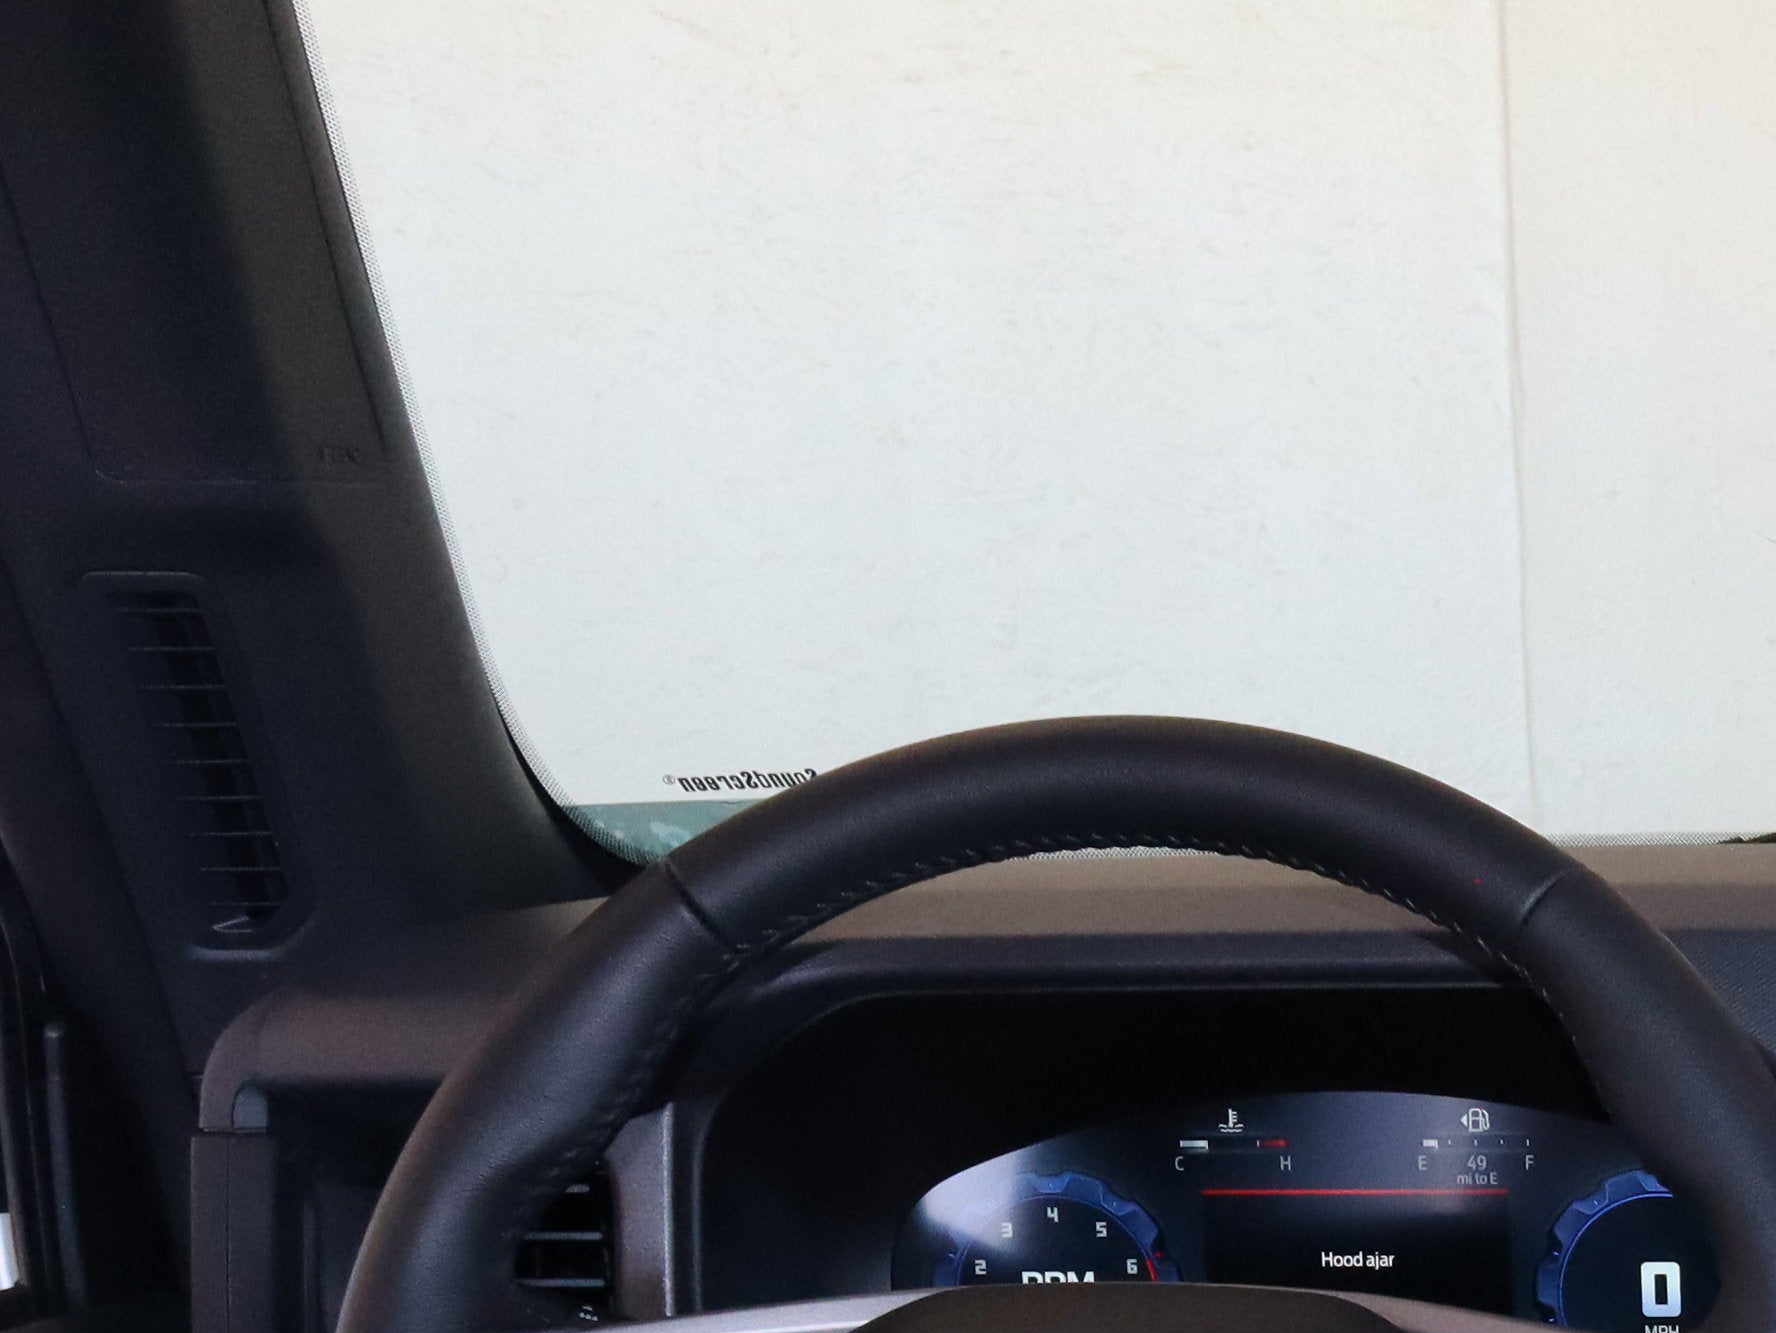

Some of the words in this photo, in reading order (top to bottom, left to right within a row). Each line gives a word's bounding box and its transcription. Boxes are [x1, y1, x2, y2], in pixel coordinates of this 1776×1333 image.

[1174, 1156, 1184, 1170] C
[1280, 1156, 1291, 1170] H
[1418, 1156, 1427, 1170] E
[1467, 1155, 1487, 1170] 49
[1525, 1155, 1534, 1170] F
[1457, 1173, 1473, 1184] mi
[1475, 1174, 1488, 1184] to
[1490, 1173, 1498, 1184] E
[1047, 1207, 1059, 1222] 4
[1001, 1222, 1013, 1238] 3
[1096, 1222, 1108, 1238] 5
[974, 1260, 987, 1275] 2
[1126, 1259, 1138, 1274] 6
[1321, 1252, 1364, 1267] Hood
[1366, 1252, 1395, 1270] ajar
[1640, 1261, 1682, 1318] 0
